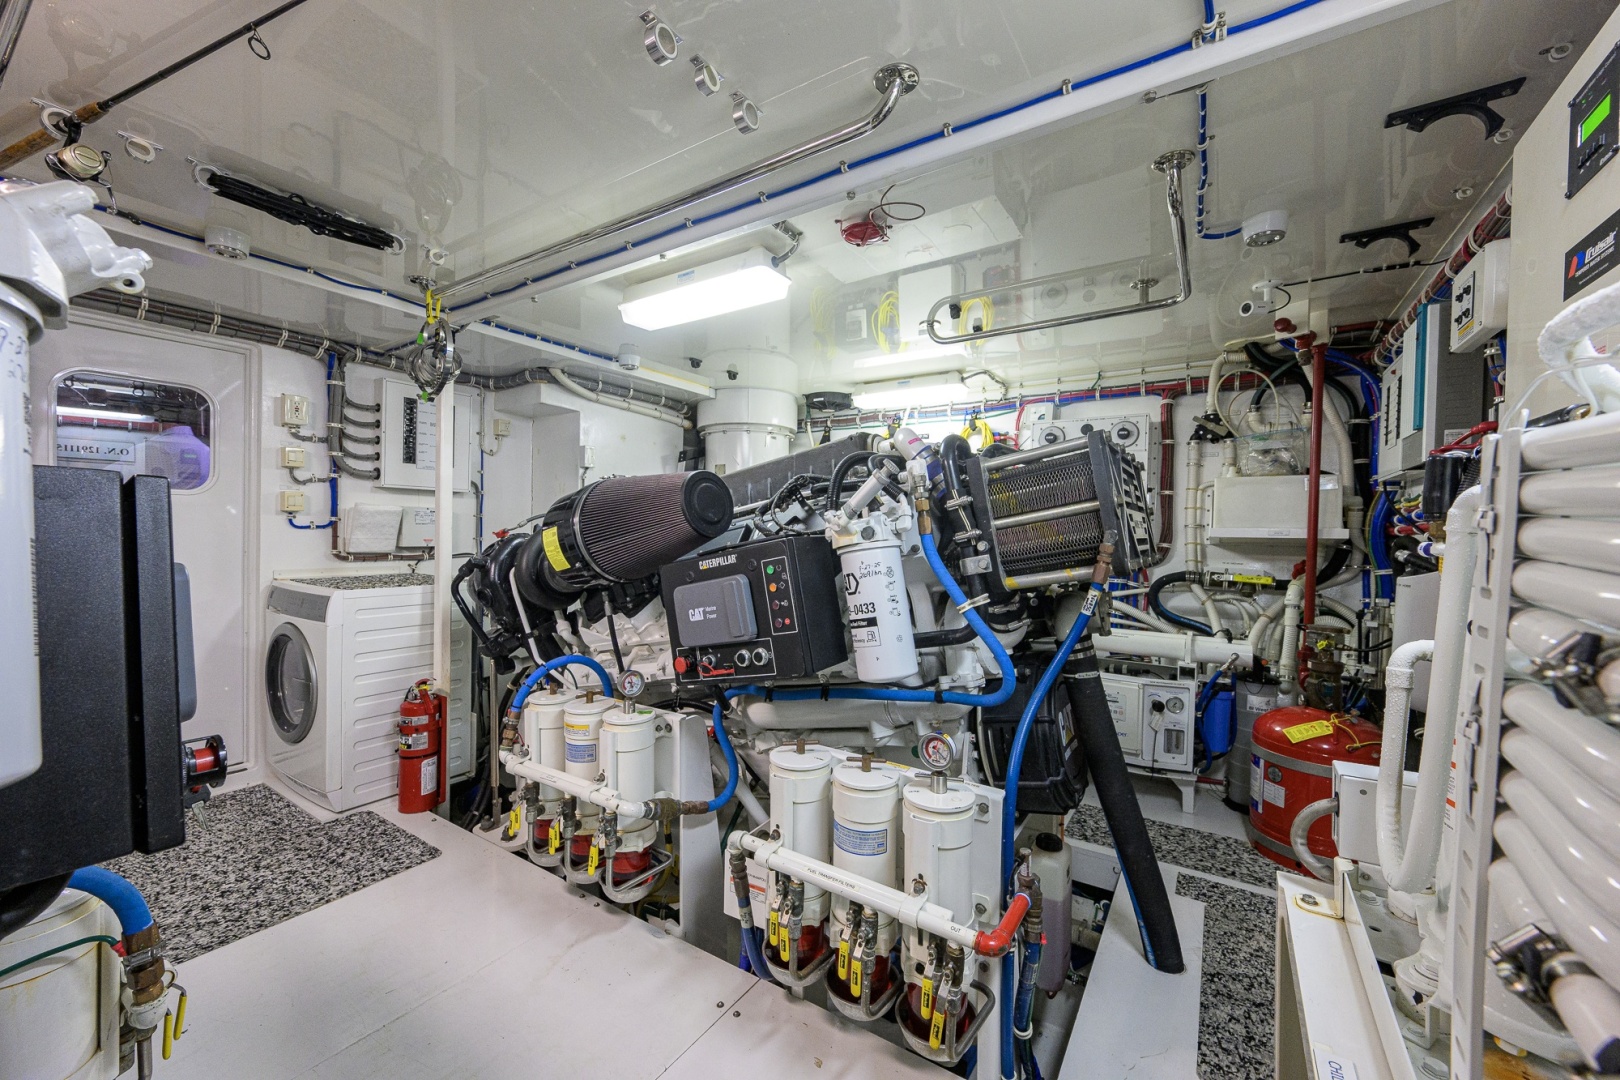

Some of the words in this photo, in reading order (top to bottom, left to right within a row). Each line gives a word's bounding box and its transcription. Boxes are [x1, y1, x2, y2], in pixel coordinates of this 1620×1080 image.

[699, 554, 737, 570] CATERPILLAR
[688, 607, 705, 622] CAT
[951, 925, 962, 934] OUT
